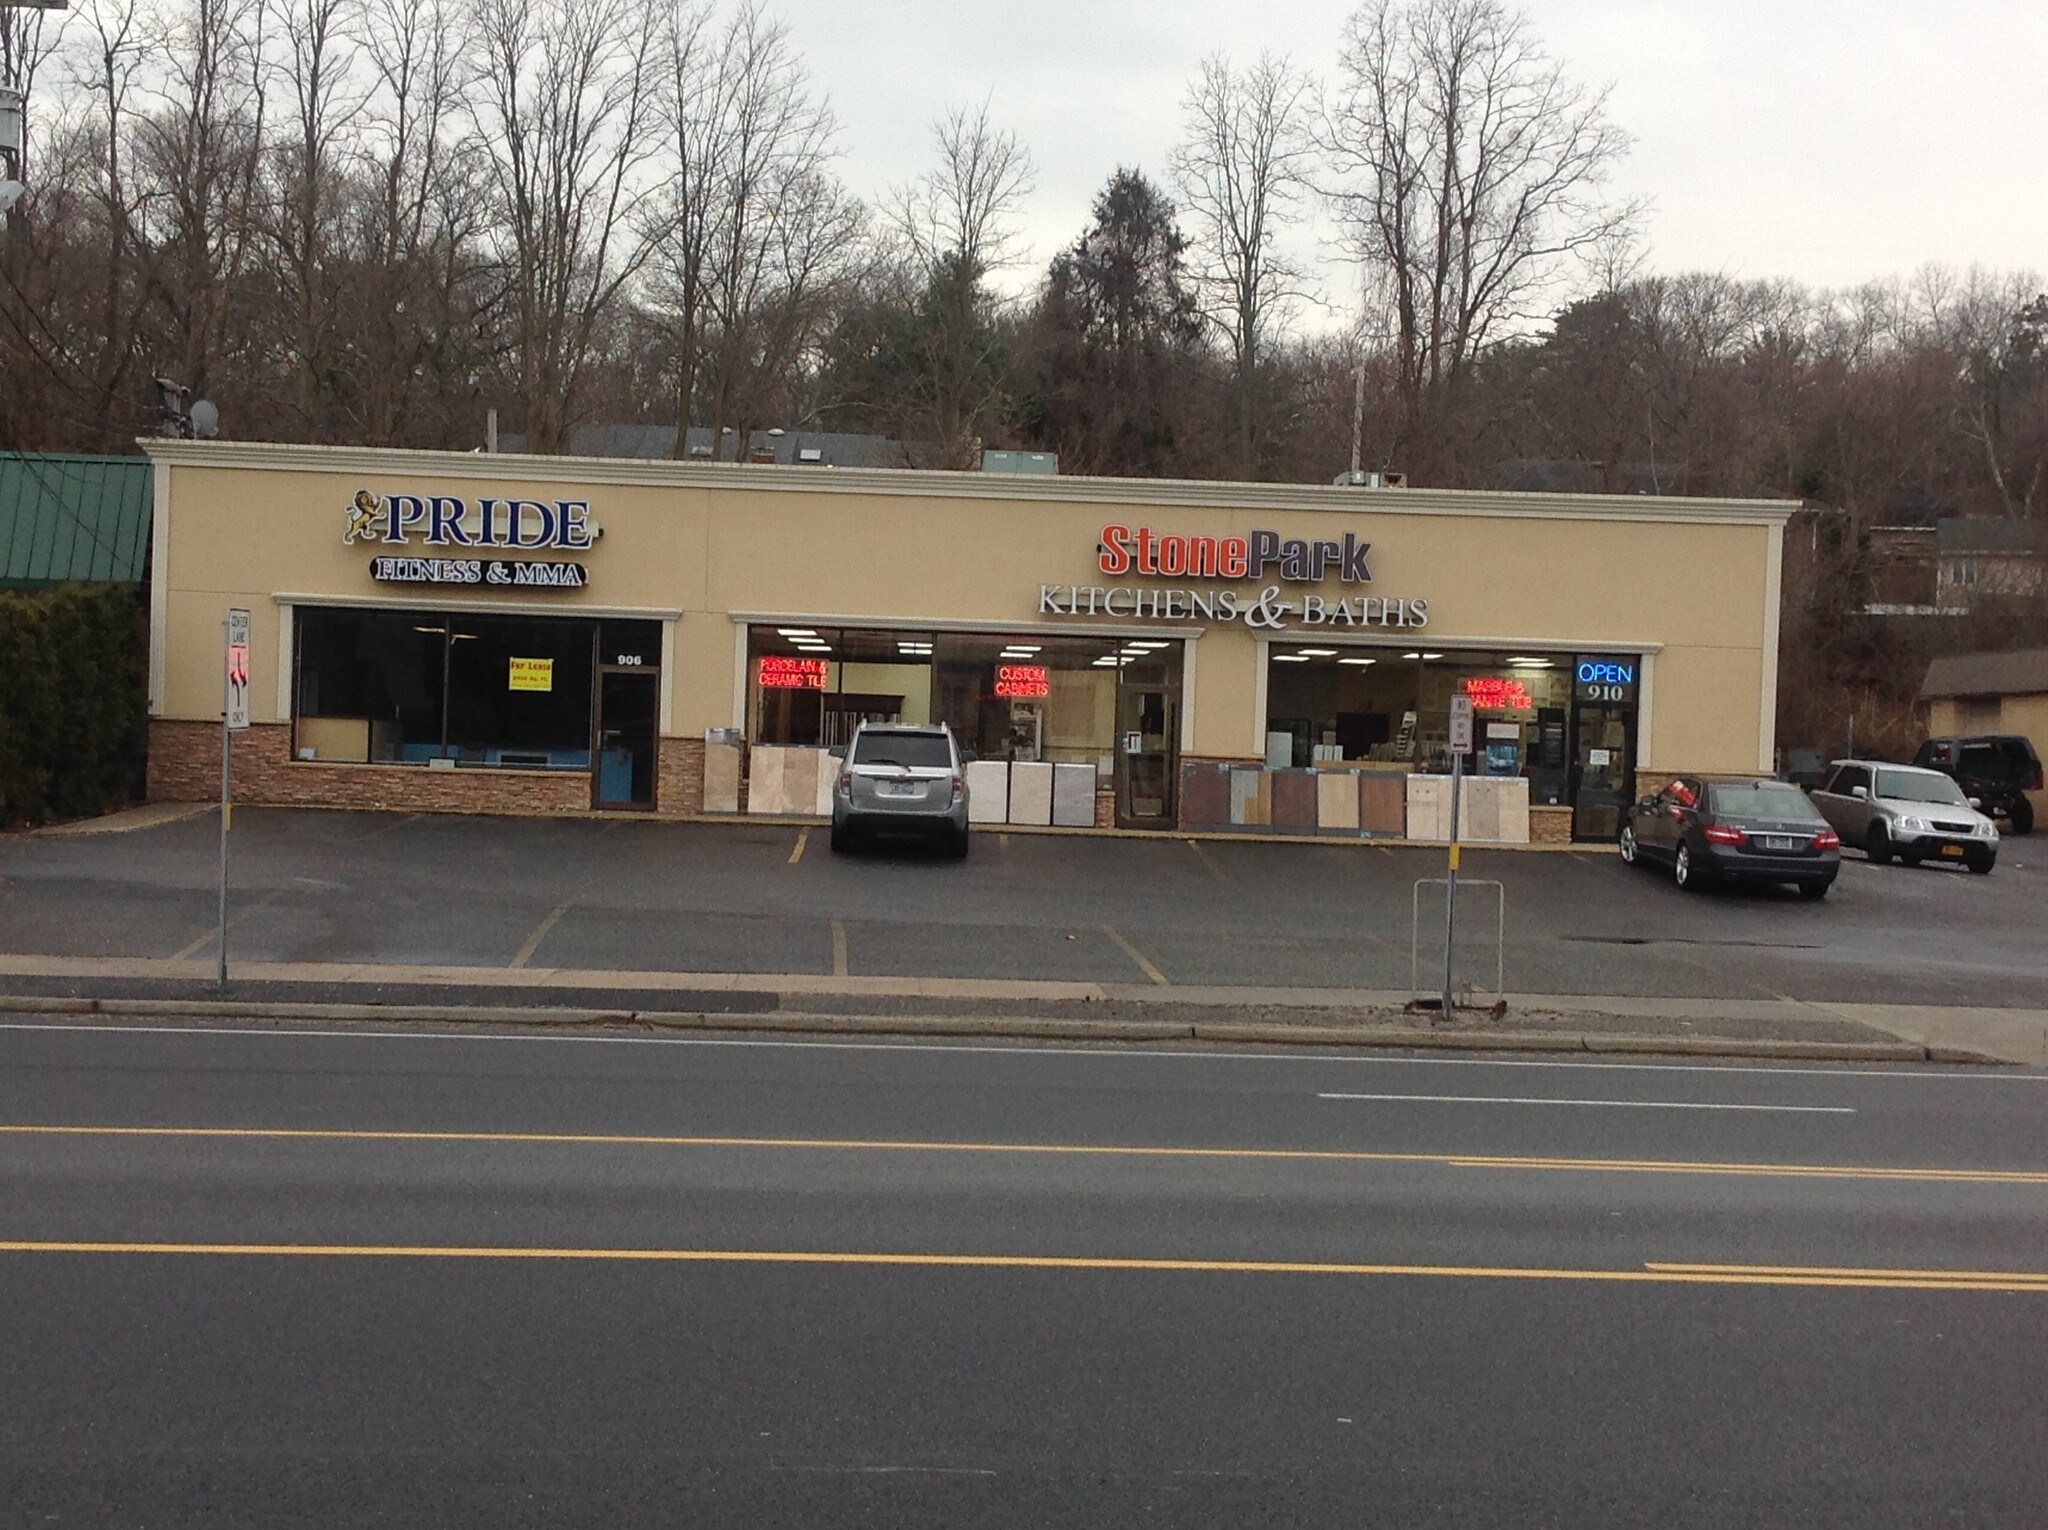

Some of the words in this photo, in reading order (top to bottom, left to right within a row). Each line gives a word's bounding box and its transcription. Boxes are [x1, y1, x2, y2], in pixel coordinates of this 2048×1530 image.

[382, 494, 593, 549] PRIDE
[1099, 523, 1373, 583] StonePark
[375, 557, 481, 583] FITNESS
[486, 561, 511, 585] &
[514, 562, 582, 587] MMA
[1038, 584, 1238, 622] KITCHENS
[1244, 585, 1293, 630] &
[1303, 594, 1429, 629] BATHS
[617, 654, 642, 666] 906
[1000, 667, 1045, 681] CUSTOM
[1579, 663, 1632, 682] OPEN
[996, 682, 1049, 696] CABINETS
[1588, 685, 1623, 701] 910
